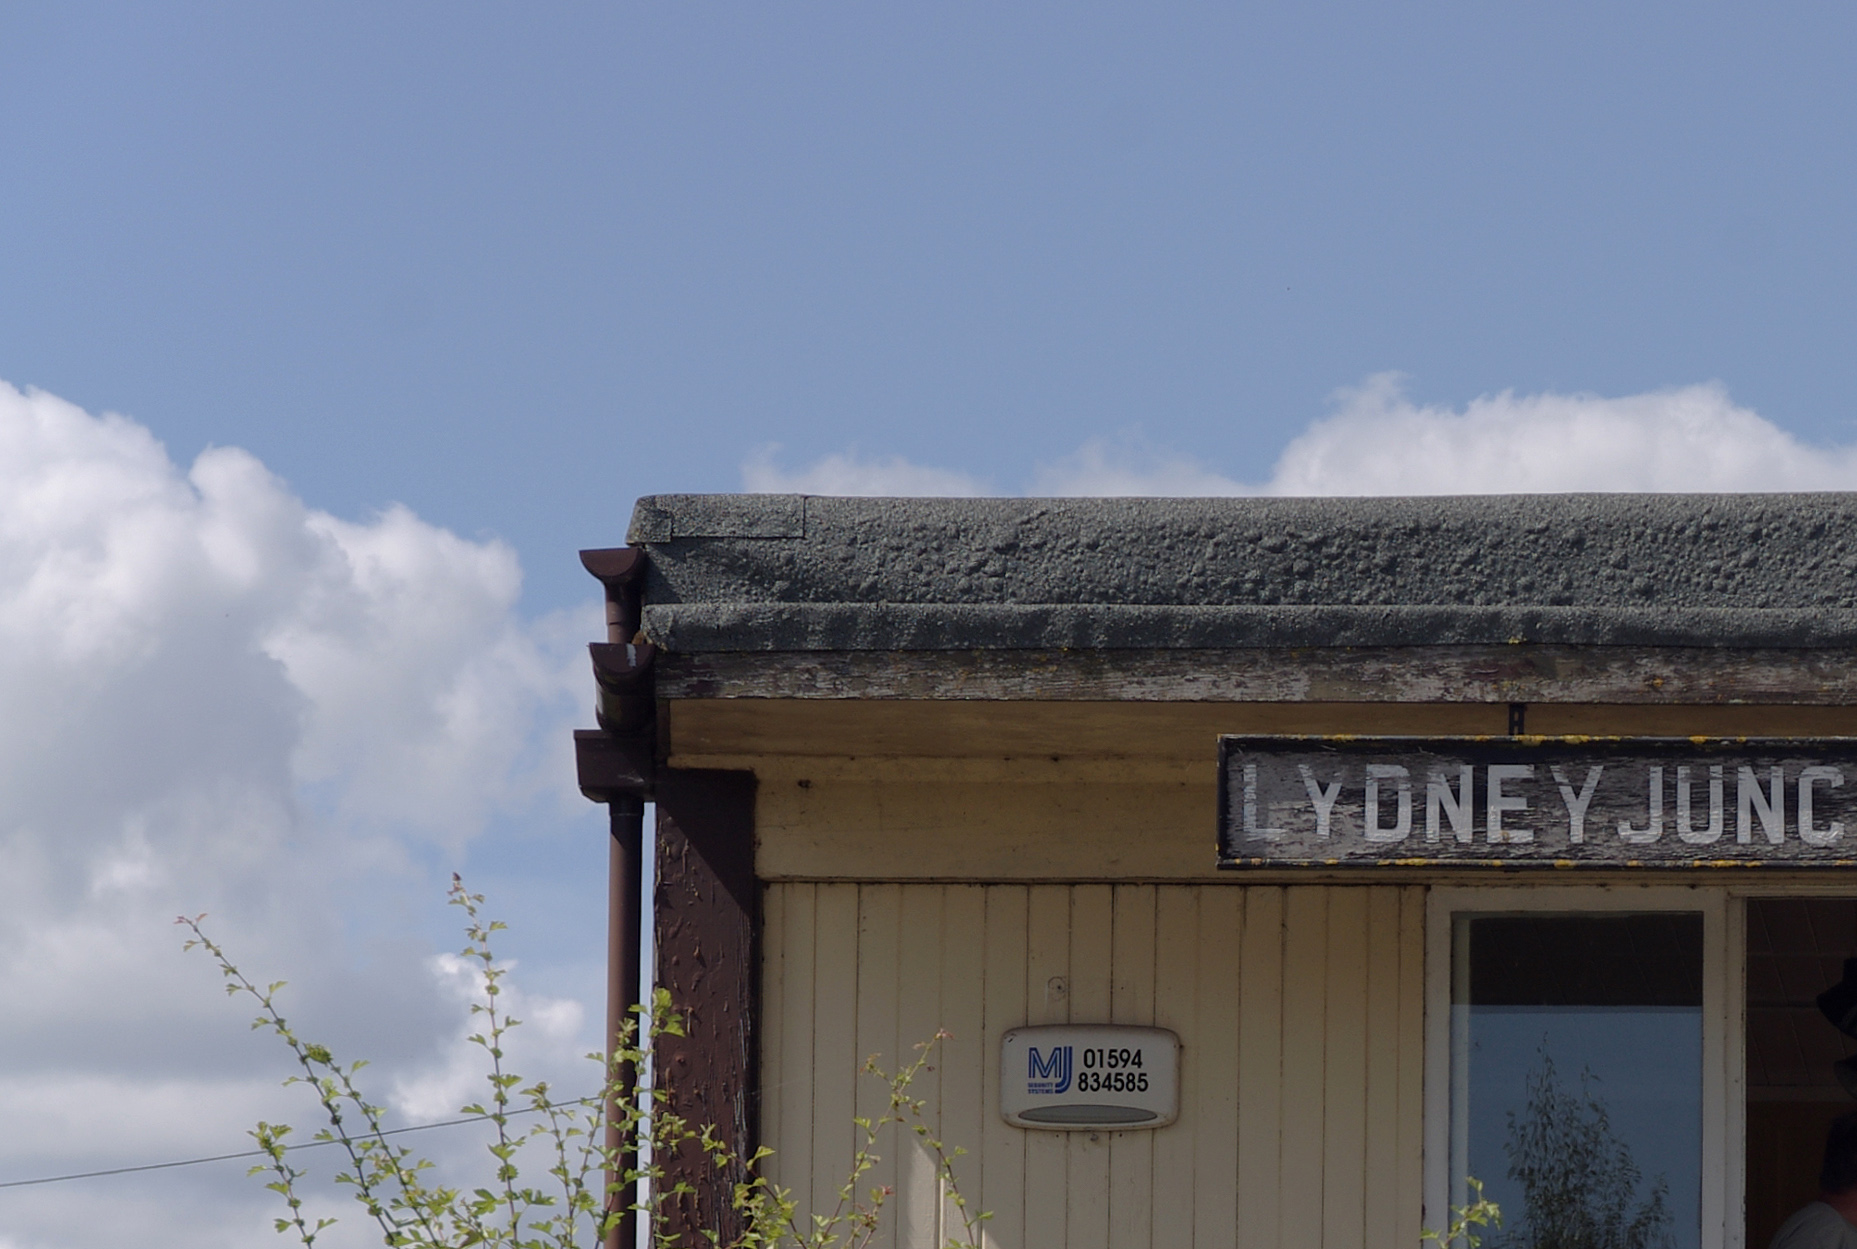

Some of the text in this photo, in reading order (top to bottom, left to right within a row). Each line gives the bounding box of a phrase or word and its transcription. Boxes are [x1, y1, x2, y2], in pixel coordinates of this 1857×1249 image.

[1241, 763, 1604, 845] LYDNEY
[1028, 1046, 1143, 1094] MJ 01594
[1078, 1072, 1148, 1092] 834585
